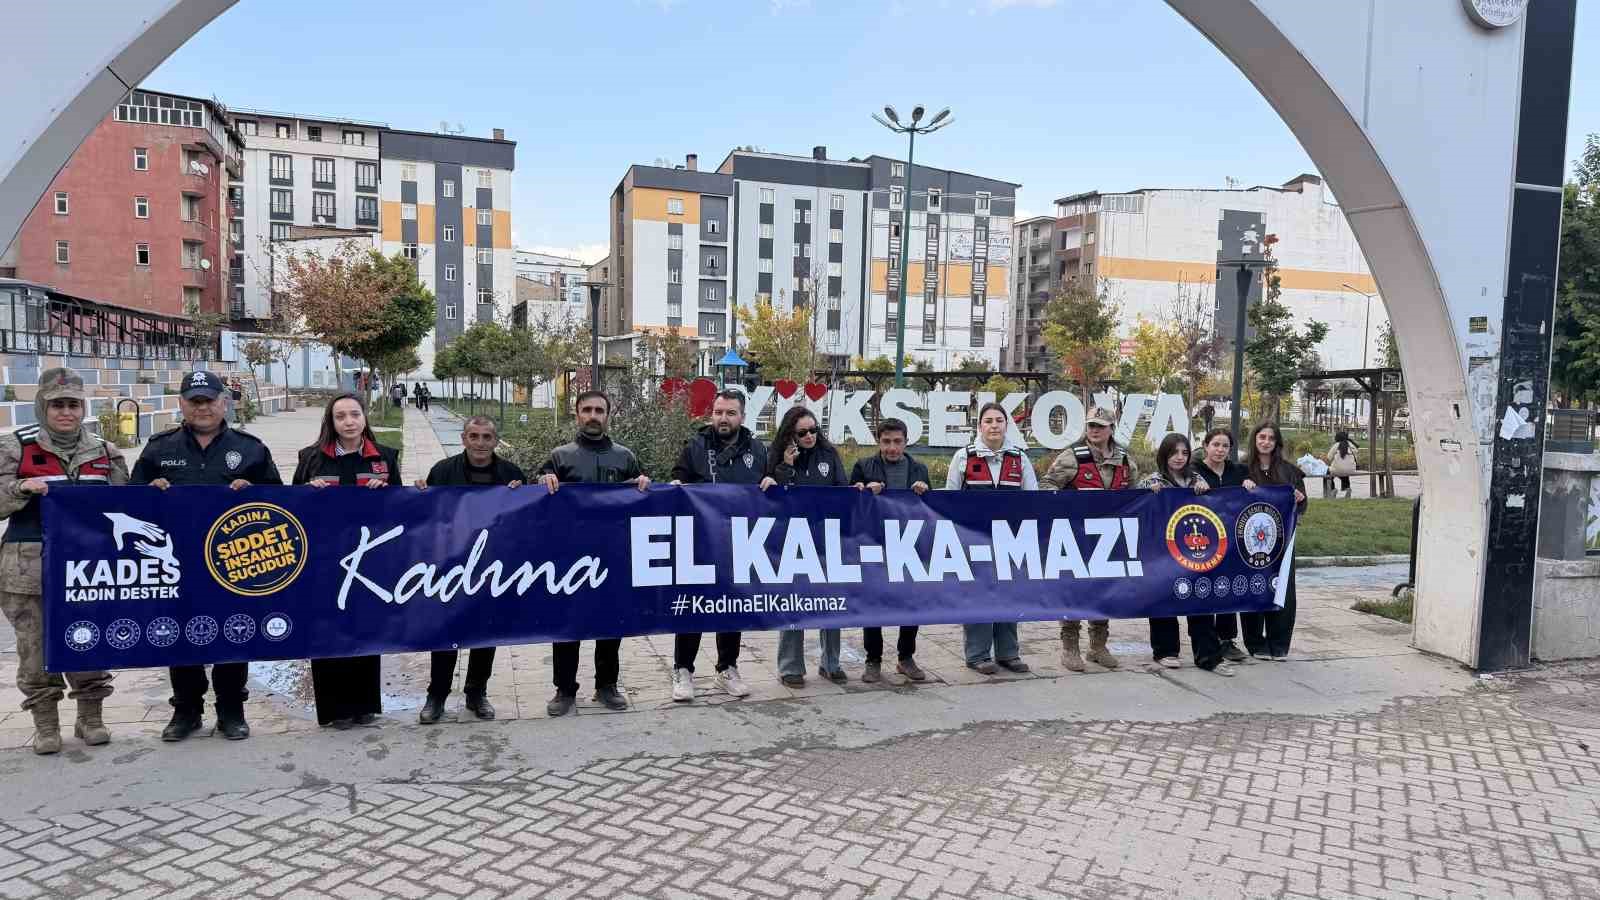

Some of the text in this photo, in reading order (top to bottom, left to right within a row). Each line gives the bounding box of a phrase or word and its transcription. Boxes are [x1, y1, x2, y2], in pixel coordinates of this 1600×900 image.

[221, 510, 271, 534] KADINA
[65, 557, 181, 587] KADES
[337, 525, 609, 610] Kadına
[631, 516, 715, 587] EL
[731, 516, 1143, 584] KAL-KA-MAZ!
[65, 586, 180, 602] KADIN DESTEK
[671, 593, 848, 616] #KadınaElKalkamaz
